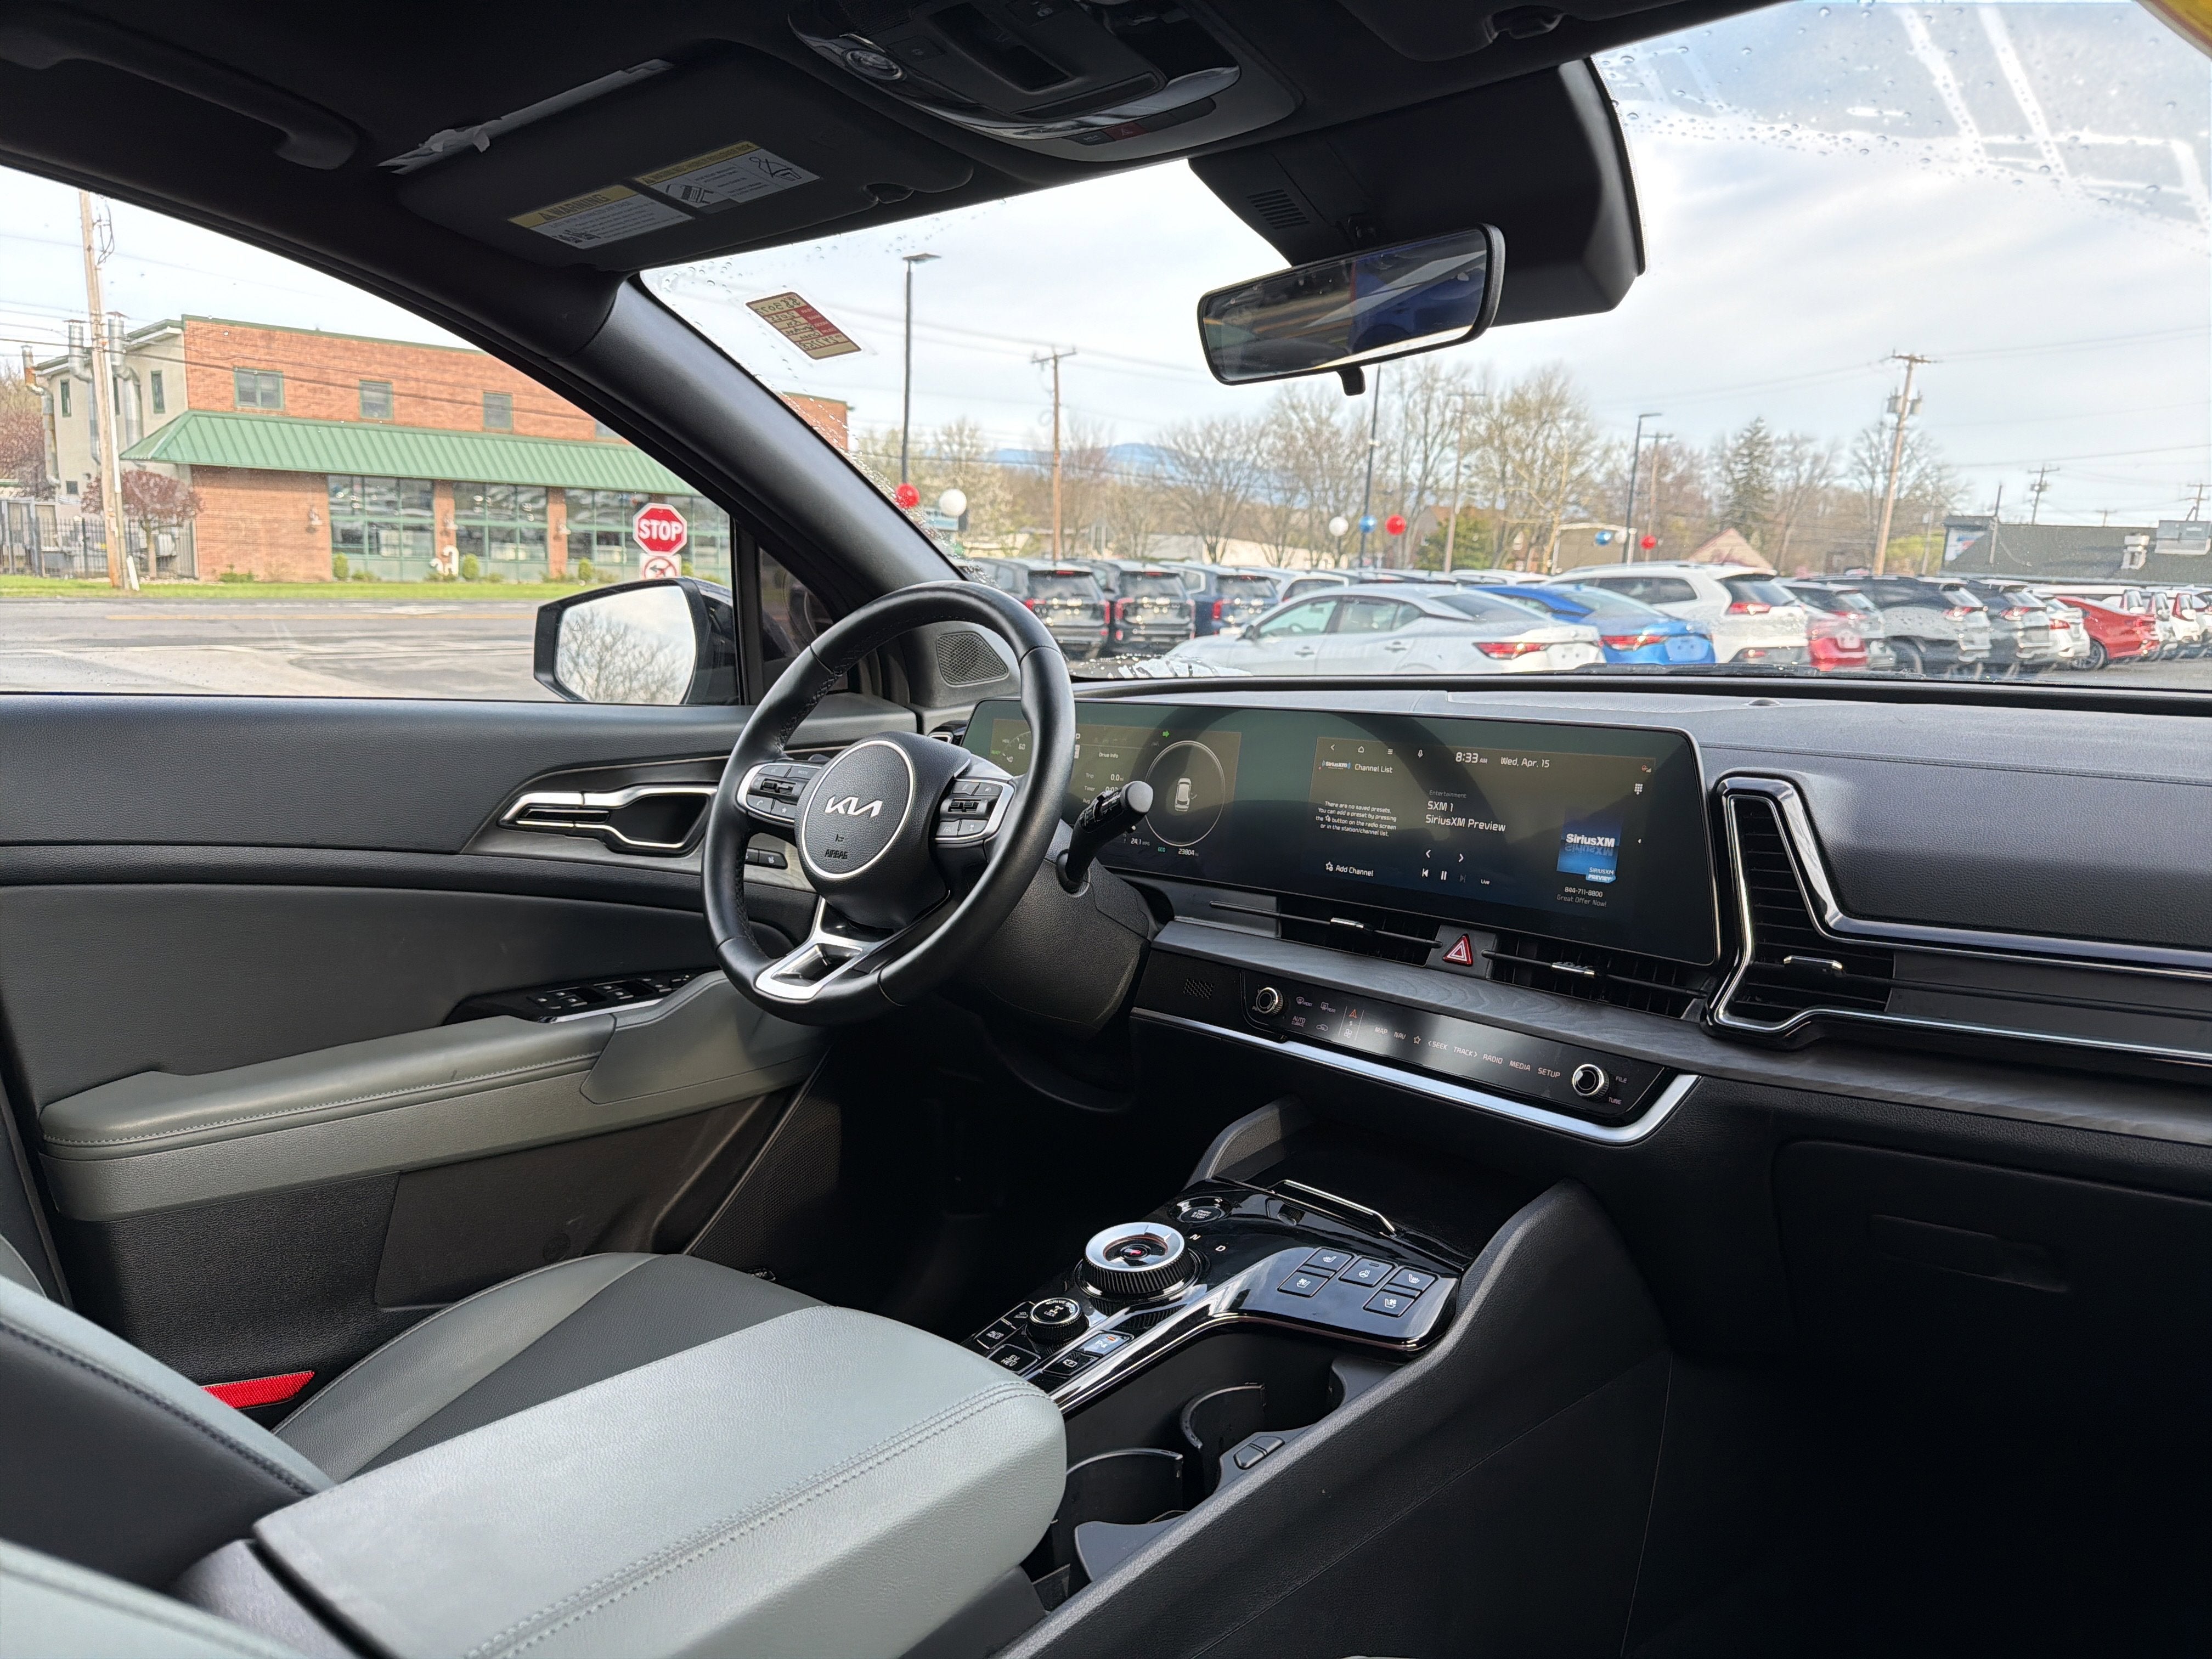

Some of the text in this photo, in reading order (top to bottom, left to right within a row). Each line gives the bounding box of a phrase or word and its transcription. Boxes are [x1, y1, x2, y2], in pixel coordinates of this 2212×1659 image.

[547, 194, 611, 216] WARNING
[639, 518, 683, 541] STOP
[1455, 752, 1479, 763] 8:33
[1500, 757, 1519, 766] Wed,
[1521, 758, 1539, 768] Apr.
[1542, 759, 1550, 768] 15
[1355, 763, 1379, 772] Channel
[1429, 789, 1467, 799] Entertainment
[825, 795, 883, 818] KIA
[1427, 800, 1453, 812] SXM 1
[1425, 814, 1506, 832] SiriusXM Preview
[1341, 826, 1379, 836] station/channel
[1566, 833, 1615, 848] SiriusXM
[825, 849, 849, 859] AIRBAG
[1348, 866, 1374, 877] Channel
[1589, 867, 1614, 875] SIRIUSXM
[1564, 887, 1603, 898] 844-711-8800
[1575, 896, 1591, 905] Offer
[1592, 899, 1607, 907] Now!
[1393, 1031, 1406, 1040] NAV
[1482, 1053, 1503, 1064] RADIO
[1509, 1060, 1531, 1071] MEDIA
[1537, 1067, 1561, 1078] SETUP
[1000, 1358, 1017, 1367] HEV
